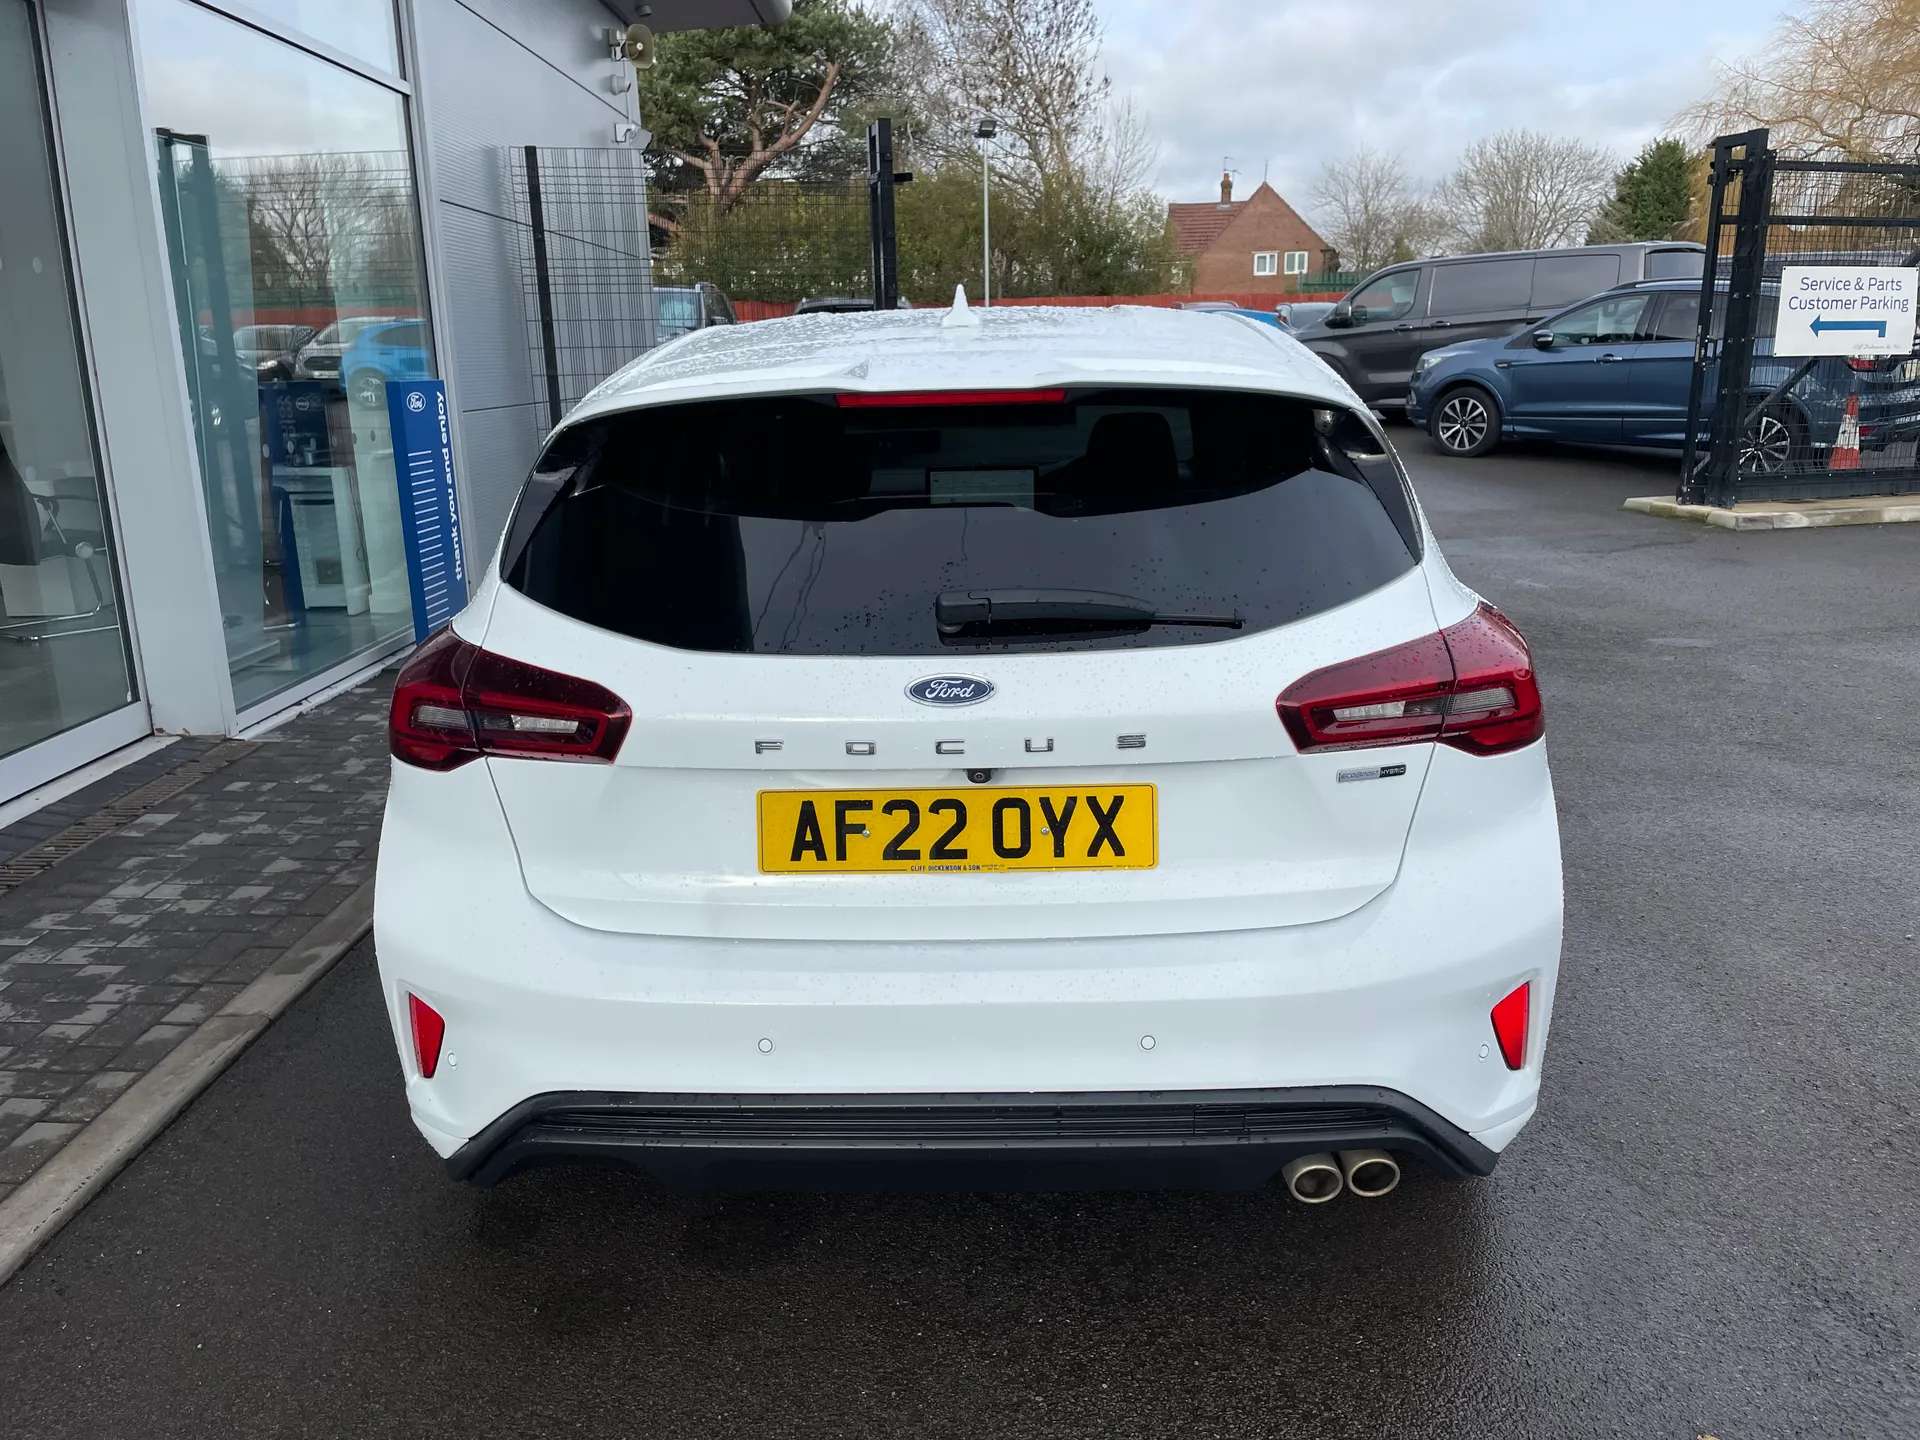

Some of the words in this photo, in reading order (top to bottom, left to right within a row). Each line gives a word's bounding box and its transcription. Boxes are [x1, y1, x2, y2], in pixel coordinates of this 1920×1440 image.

[1799, 277, 1851, 291] Service
[1854, 278, 1864, 291] &
[1868, 277, 1902, 291] Parts
[1788, 296, 1857, 310] Customer
[1860, 296, 1909, 312] Parking
[436, 391, 448, 445] enjoy
[442, 447, 453, 485] and
[448, 488, 458, 523] you
[451, 525, 462, 582] thank
[925, 679, 975, 698] Ford
[754, 733, 1147, 755] FOCUS
[790, 798, 968, 862] AF22
[992, 795, 1126, 859] OYX
